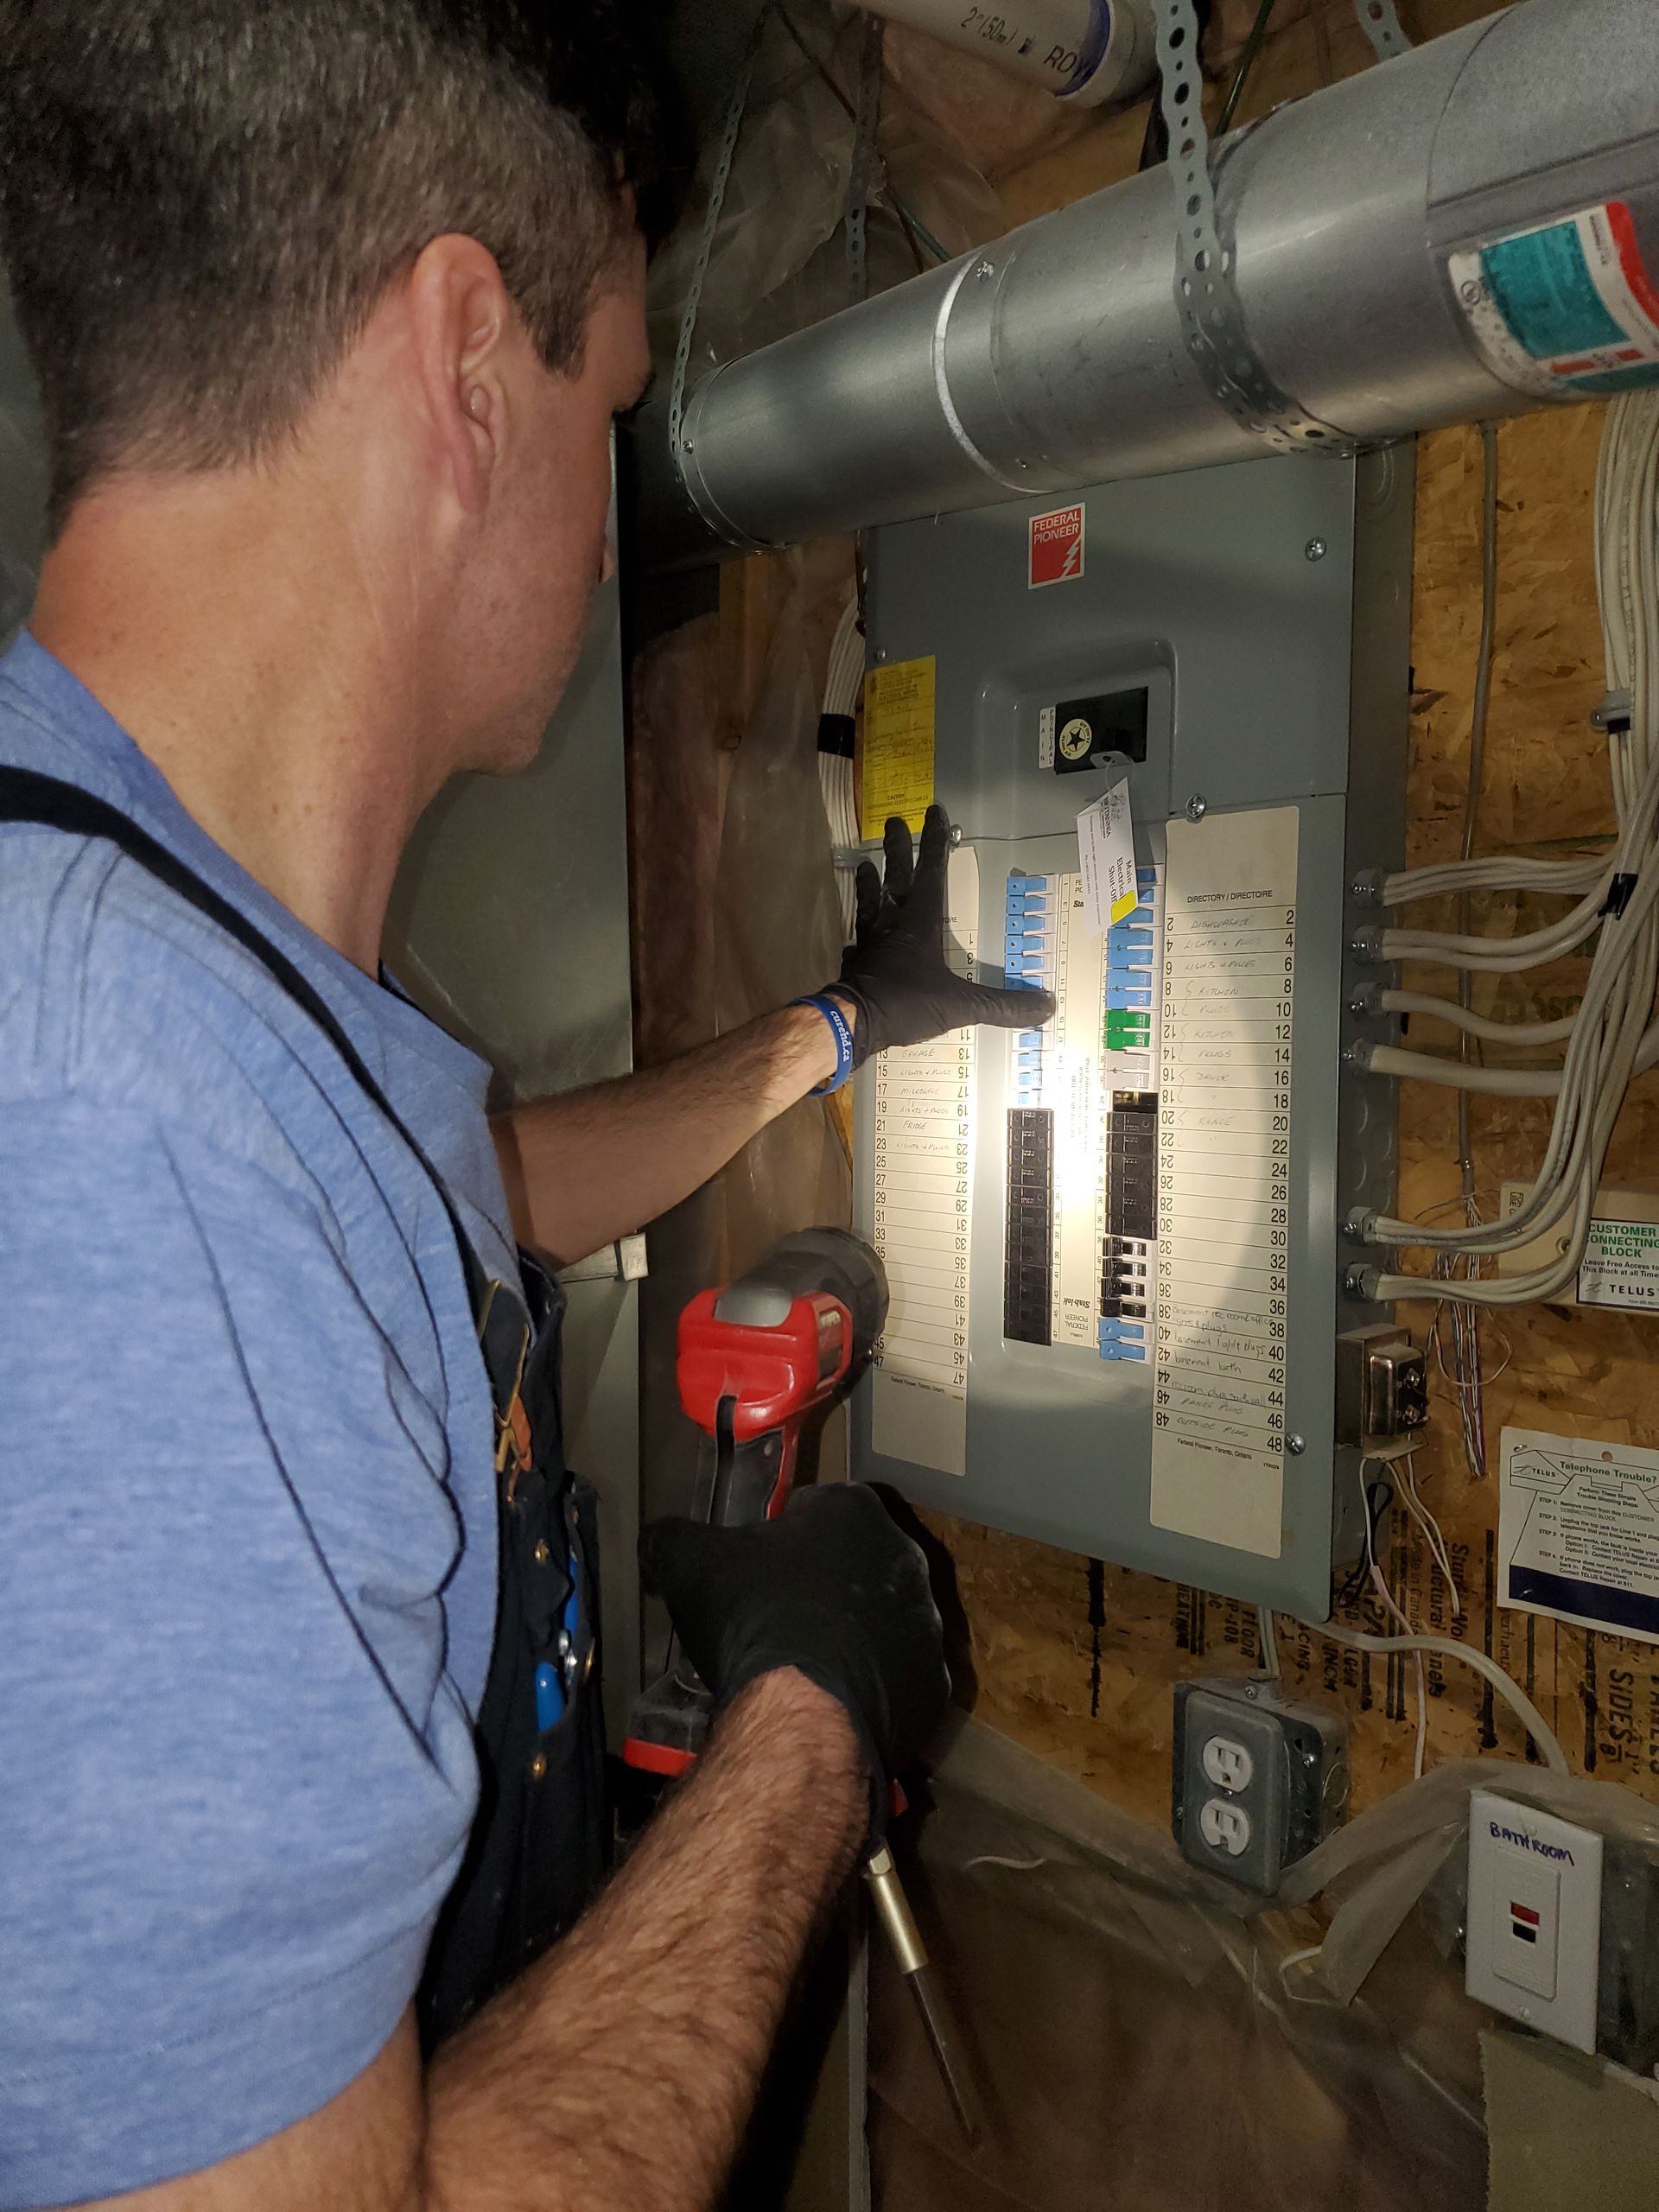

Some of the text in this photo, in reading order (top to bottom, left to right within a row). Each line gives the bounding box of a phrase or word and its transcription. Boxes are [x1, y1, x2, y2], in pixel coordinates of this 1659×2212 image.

[1034, 511, 1080, 532] FEDERAL
[1034, 523, 1078, 545] PIONEER
[1109, 865, 1118, 903] Shut-Off
[1116, 857, 1126, 899] Electrical
[1187, 890, 1273, 904] DIRECTORY DIRECTOIRE
[1166, 918, 1174, 931] 2
[1286, 910, 1294, 925] 2
[969, 933, 974, 945] 1
[1285, 932, 1294, 948] 4
[1166, 961, 1173, 976] 6
[1284, 957, 1293, 972] 6
[966, 972, 973, 982] 5
[1284, 978, 1292, 994] 8
[1164, 1003, 1177, 1018] 10
[1275, 1001, 1291, 1017] 10
[830, 1010, 852, 1063] curehd.ca
[1275, 1025, 1291, 1039] 12
[958, 1047, 969, 1060] 13
[1163, 1046, 1176, 1061] 14
[1274, 1047, 1290, 1063] 14
[878, 1065, 888, 1077] 15
[1274, 1070, 1289, 1085] 16
[877, 1083, 887, 1095] 17
[1161, 1089, 1175, 1103] 18
[877, 1101, 887, 1113] 19
[1274, 1093, 1288, 1109] 18
[876, 1119, 886, 1131] 21
[903, 1121, 927, 1130] FRIDGE
[1272, 1116, 1288, 1131] 20
[876, 1137, 887, 1150] 23
[1161, 1132, 1174, 1147] 22
[1272, 1139, 1287, 1154] 22
[957, 1142, 968, 1156] 23
[876, 1155, 887, 1167] 25
[1271, 1162, 1287, 1178] 24
[875, 1173, 886, 1186] 27
[1160, 1175, 1173, 1190] 26
[875, 1192, 886, 1204] 29
[1271, 1185, 1287, 1200] 26
[875, 1210, 885, 1222] 31
[1270, 1208, 1287, 1224] 28
[957, 1218, 967, 1232] 31
[1159, 1217, 1173, 1233] 30
[1589, 1224, 1657, 1237] CUSTOMER
[875, 1228, 886, 1240] 33
[1270, 1230, 1287, 1246] 30
[1590, 1235, 1659, 1249] ONNECTING
[1601, 1247, 1642, 1258] BLOCK
[1159, 1261, 1172, 1276] 34
[1270, 1253, 1286, 1269] 32
[1584, 1258, 1605, 1268] Leave
[1606, 1260, 1623, 1268] Free
[1624, 1262, 1651, 1270] Access
[1582, 1266, 1598, 1274] This
[1269, 1275, 1286, 1292] 34
[1609, 1284, 1655, 1297] TELUS
[954, 1294, 966, 1308] 39
[1269, 1299, 1285, 1315] 36
[1065, 1313, 1089, 1323] PIONEER
[1158, 1304, 1171, 1319] 38
[1065, 1320, 1089, 1332] FEDERAL
[1268, 1321, 1285, 1338] 38
[953, 1351, 965, 1365] 45
[1158, 1346, 1171, 1363] 42
[1268, 1344, 1284, 1361] 40
[874, 1356, 885, 1368] 47
[1268, 1367, 1284, 1383] 42
[1157, 1389, 1170, 1405] 46
[1268, 1390, 1284, 1407] 44
[1267, 1412, 1283, 1429] 46
[1267, 1435, 1282, 1452] 48
[1214, 1446, 1234, 1458] Toronto,
[1532, 1461, 1657, 1484] TELUS Telephone Trouble?
[1577, 1492, 1598, 1501] Trouble
[1599, 1496, 1622, 1505] Shooting
[1579, 1486, 1599, 1495] Perform
[1618, 1493, 1637, 1503] Simple
[1560, 1501, 1582, 1510] Remove
[1599, 1506, 1611, 1515] from
[1622, 1511, 1656, 1522] CUSTOMER
[1560, 1507, 1598, 1518] CONNECTING
[1560, 1517, 1580, 1528] Unplug
[1590, 1522, 1599, 1530] top
[1587, 1527, 1598, 1535] that
[1598, 1529, 1609, 1538] you
[1559, 1567, 1617, 1584] Contact TELUS Repair
[1428, 1649, 1446, 1699] anels
[1608, 1668, 1635, 1742] SIDES
[1489, 1821, 1574, 1866] BATHROOM
